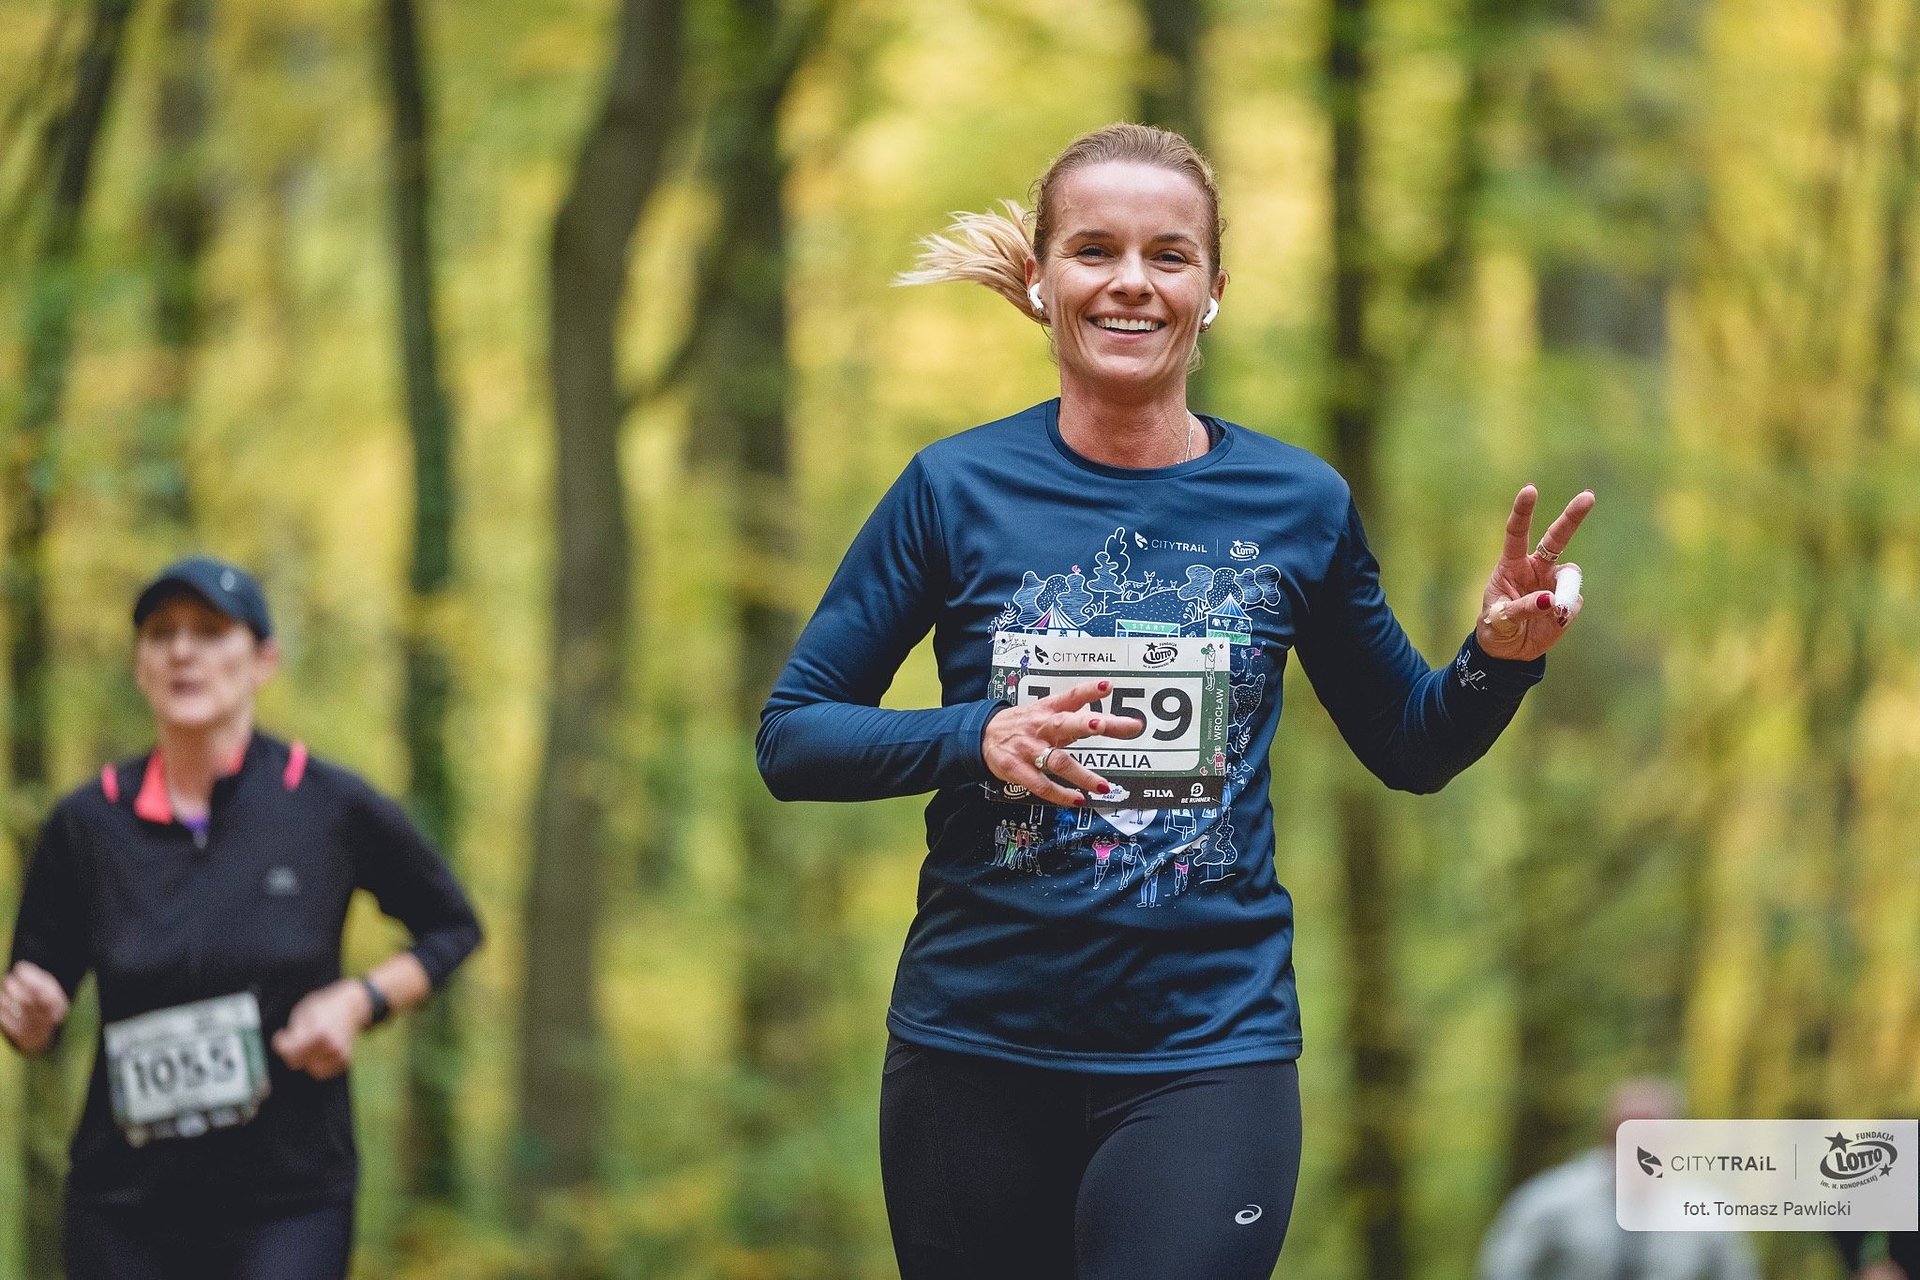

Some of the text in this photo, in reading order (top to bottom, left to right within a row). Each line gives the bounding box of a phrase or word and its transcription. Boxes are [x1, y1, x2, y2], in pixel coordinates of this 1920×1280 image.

[1132, 623, 1165, 631] START
[1150, 650, 1171, 660] LOTTO
[1028, 685, 1193, 741] 59
[1214, 688, 1224, 741] WROCŁAW
[1070, 753, 1151, 769] NATALIA
[1143, 789, 1174, 797] SILVA
